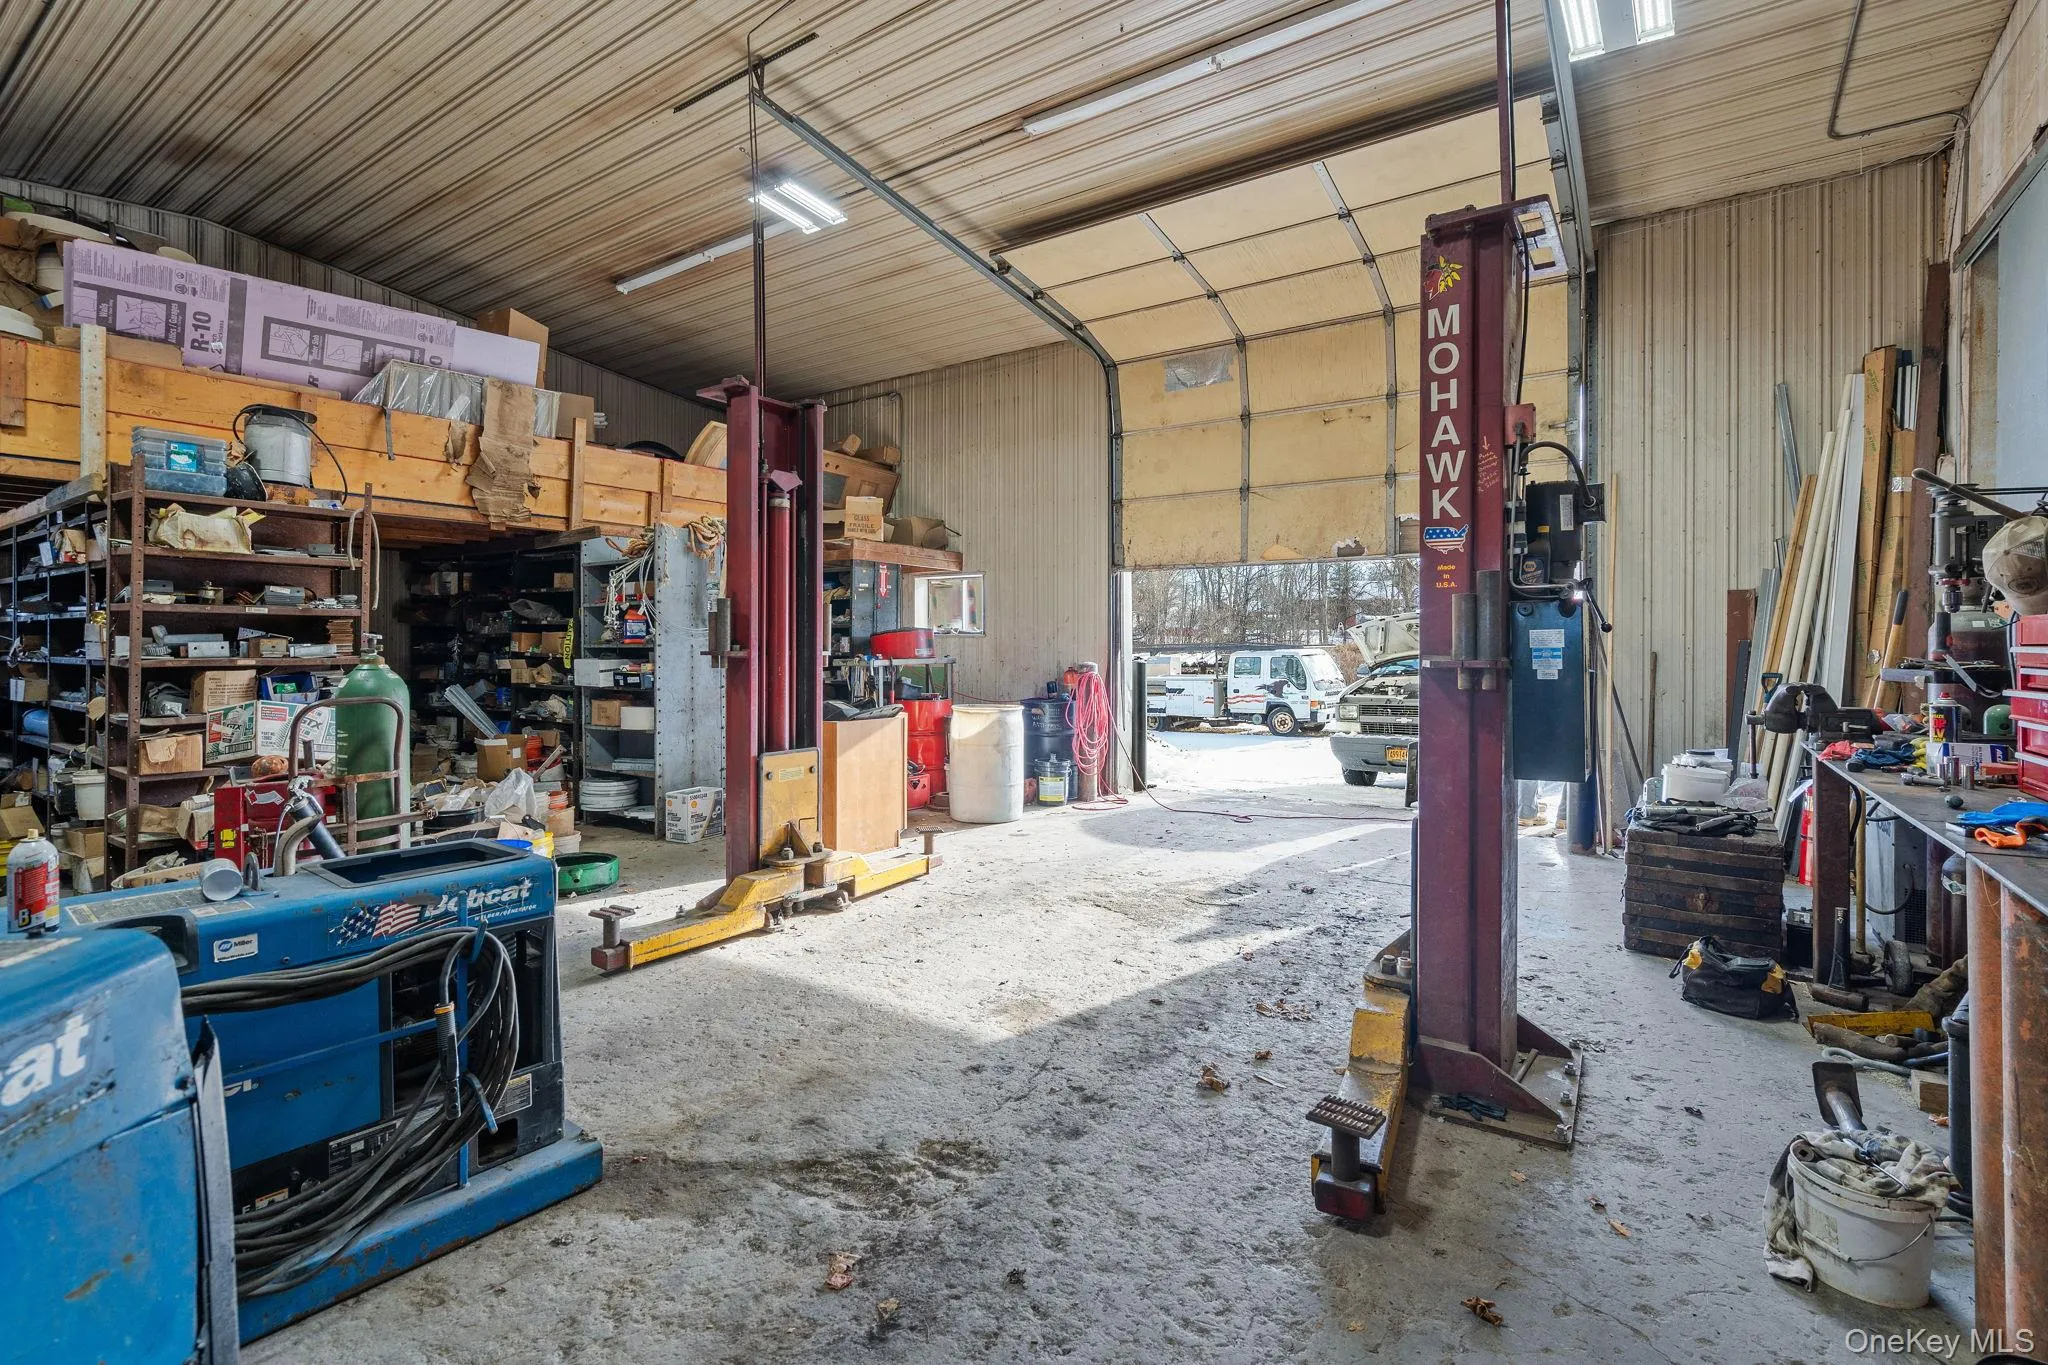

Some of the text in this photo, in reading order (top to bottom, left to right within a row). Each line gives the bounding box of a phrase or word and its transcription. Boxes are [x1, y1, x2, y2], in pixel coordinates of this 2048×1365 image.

[99, 303, 108, 318] Walls
[168, 303, 178, 324] Garages
[167, 326, 177, 344] Attics
[190, 310, 212, 353] R-10
[1426, 303, 1466, 520] MOHAWK
[226, 723, 242, 731] GTX
[233, 939, 254, 947] Miller
[0, 1014, 91, 1107] at
